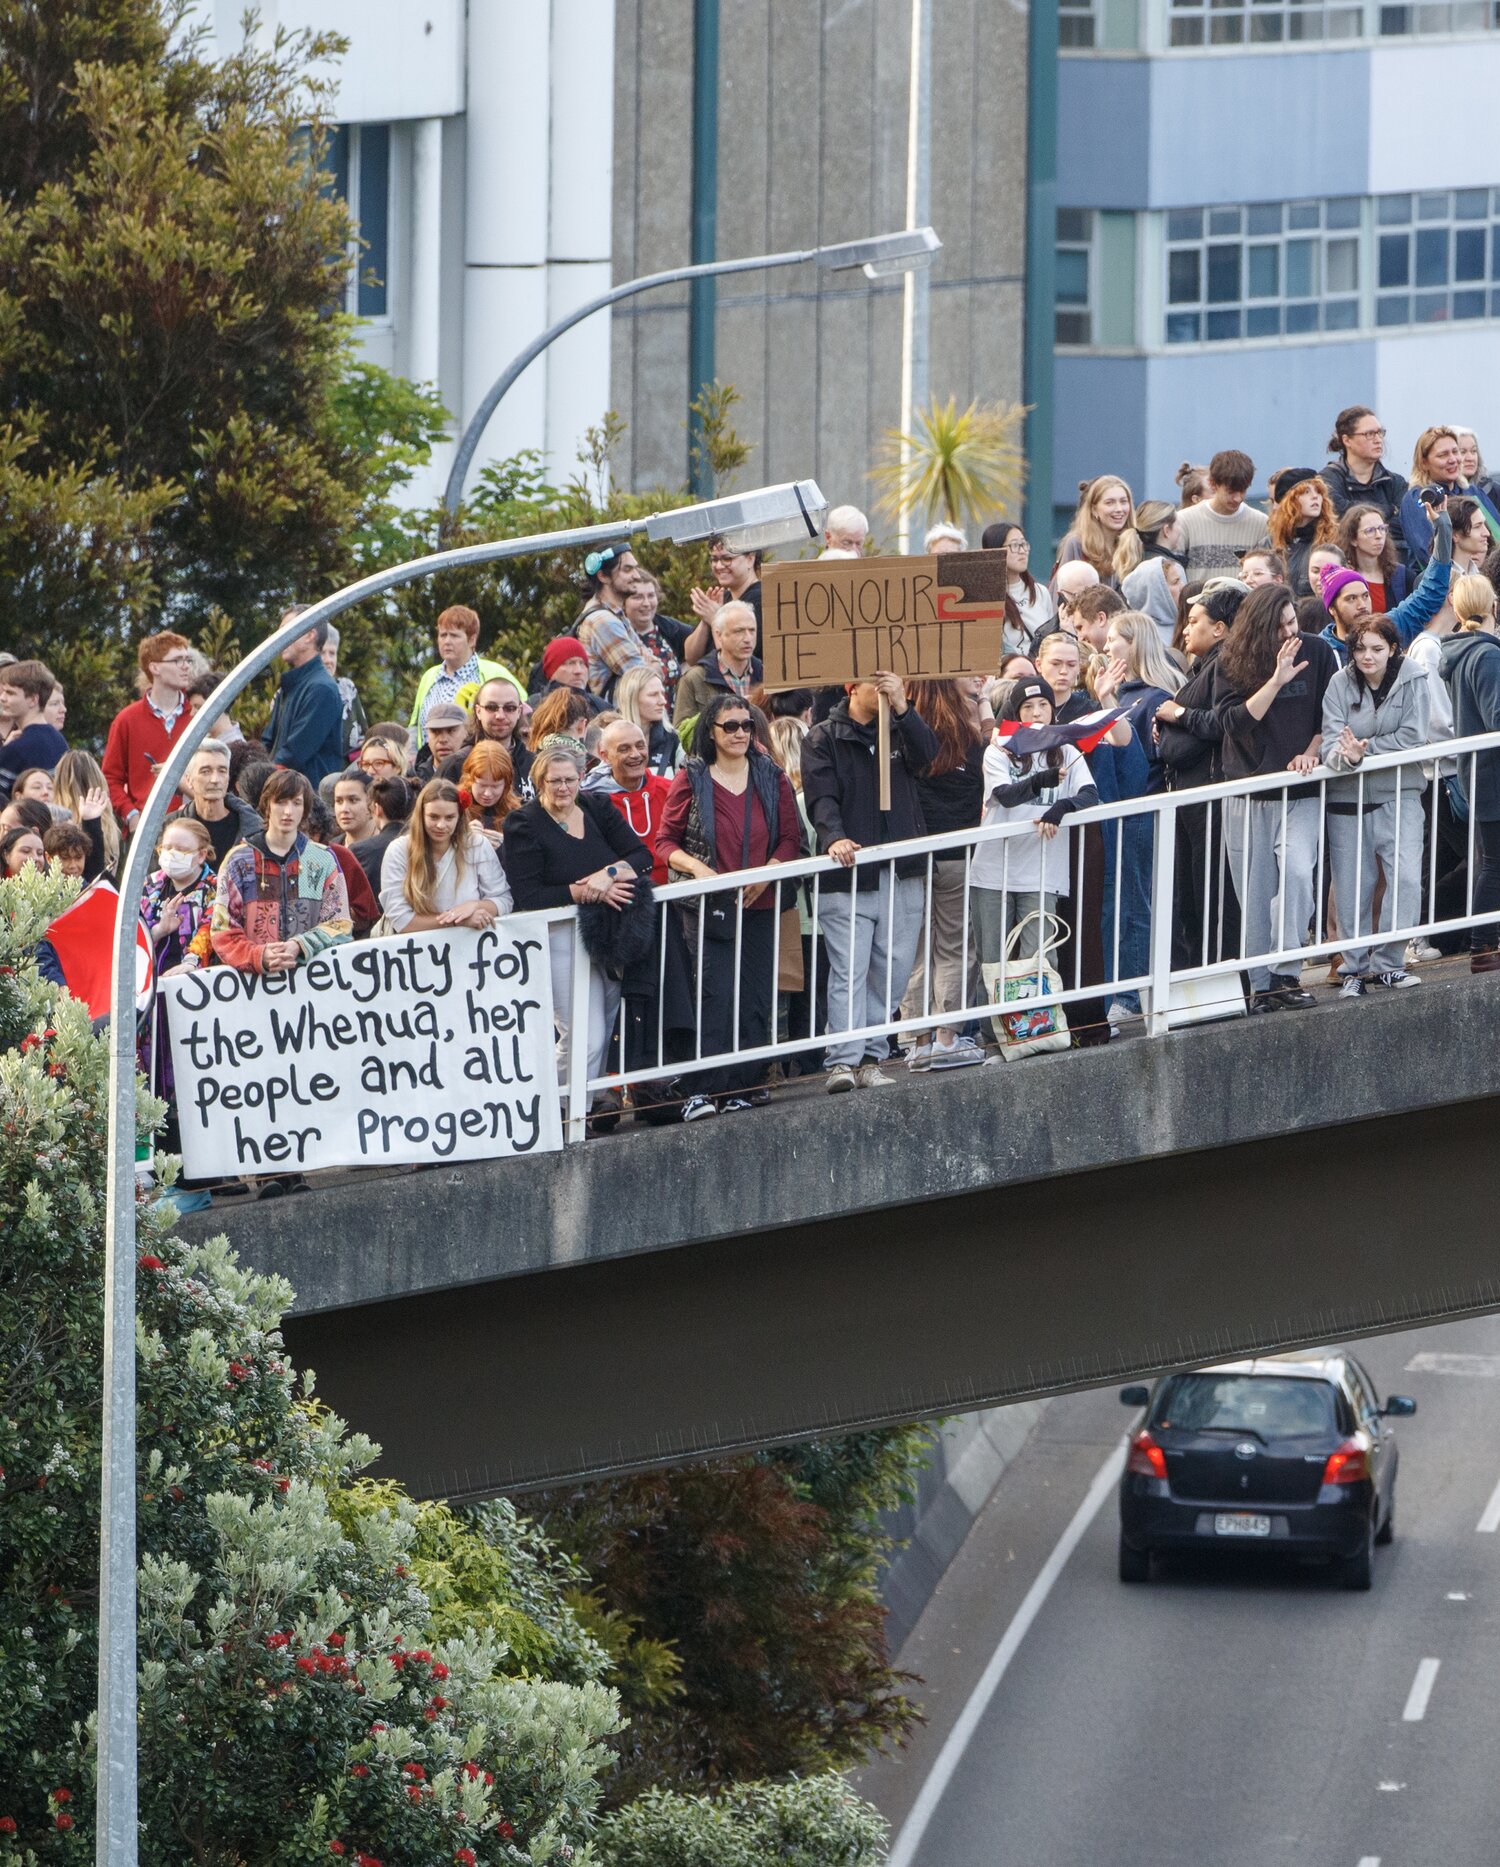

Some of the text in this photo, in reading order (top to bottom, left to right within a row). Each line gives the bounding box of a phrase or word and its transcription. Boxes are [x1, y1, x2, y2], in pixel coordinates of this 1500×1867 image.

[777, 574, 938, 631] HONOUR
[770, 619, 977, 682] TE TIRITI
[469, 931, 542, 992] for
[180, 989, 541, 1070] the Whenua, her
[360, 1041, 444, 1096] and
[463, 1034, 534, 1085] all
[234, 1116, 322, 1164] her
